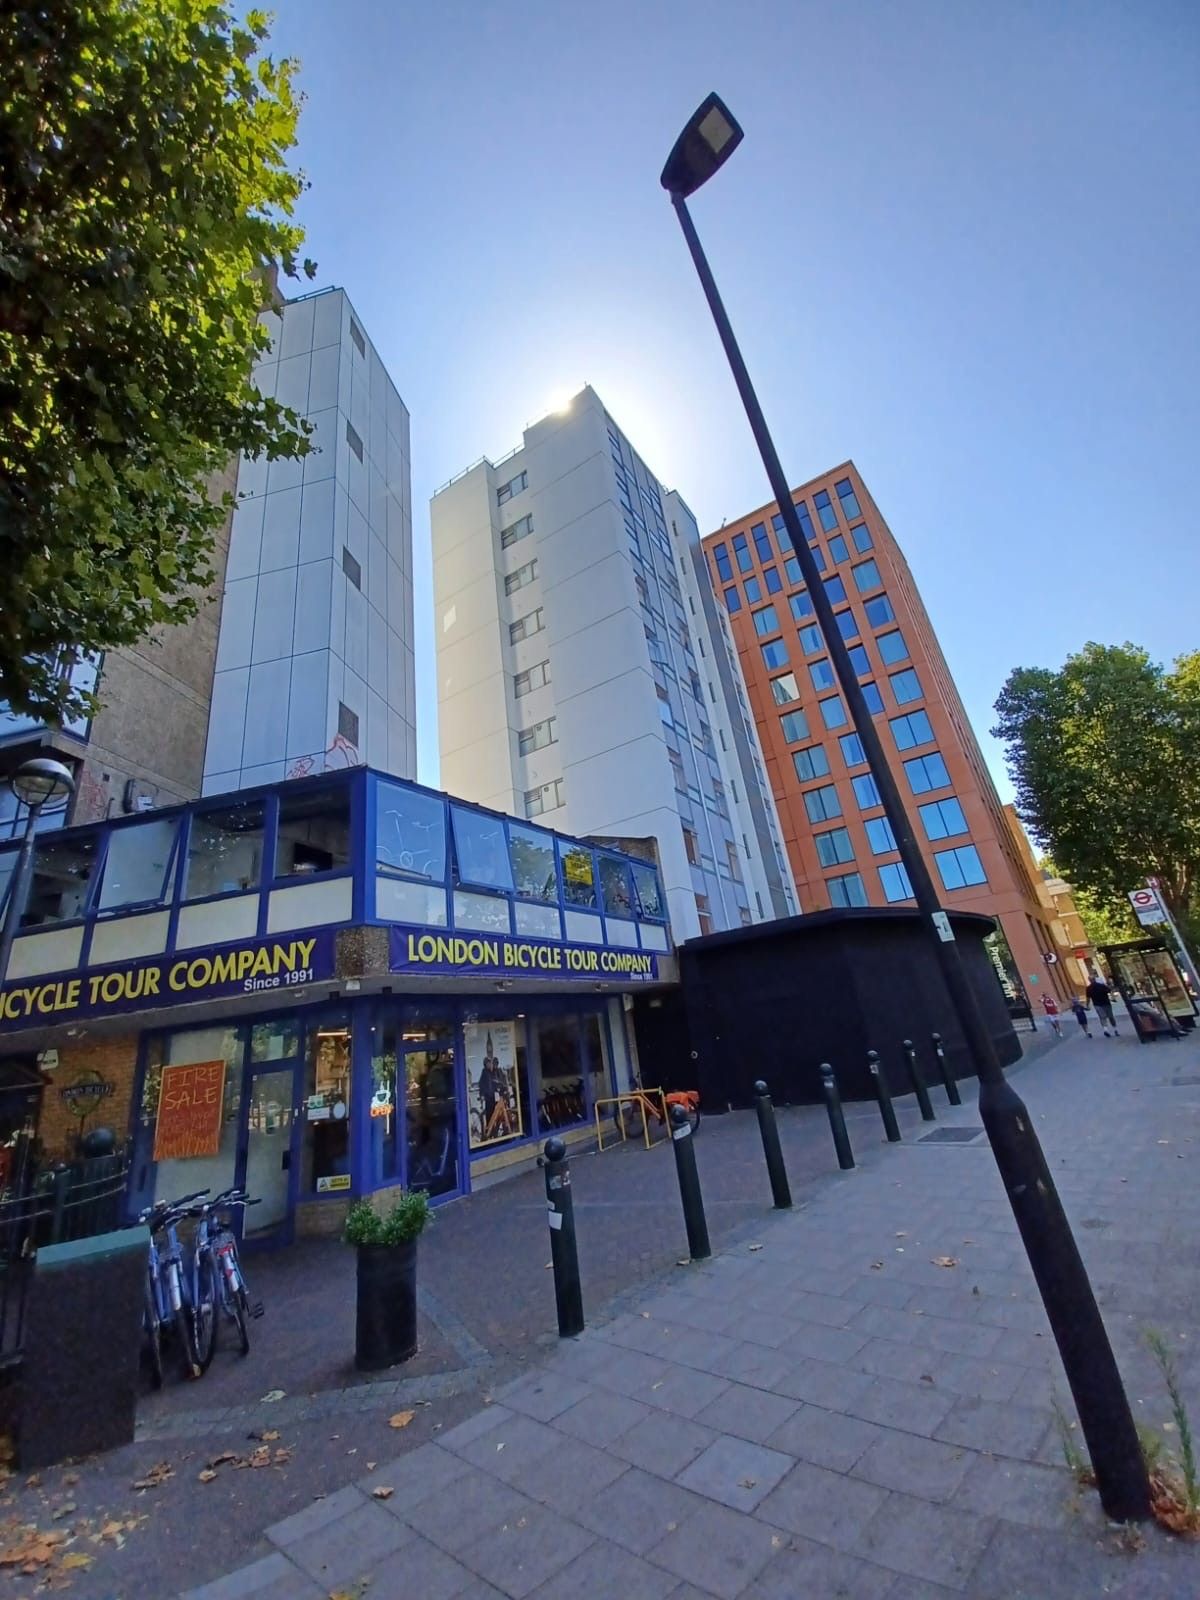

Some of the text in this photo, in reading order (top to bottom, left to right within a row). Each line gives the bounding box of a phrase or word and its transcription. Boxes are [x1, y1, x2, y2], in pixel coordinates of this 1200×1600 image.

[408, 934, 652, 973] LONDON BICYCLE TOUR COMPANY
[989, 946, 1009, 983] Premier
[89, 967, 161, 1003] TOUR
[169, 938, 317, 992] COMPANY
[244, 968, 314, 992] Since 1991
[167, 1066, 219, 1090] FIRE
[165, 1086, 218, 1110] SALE
